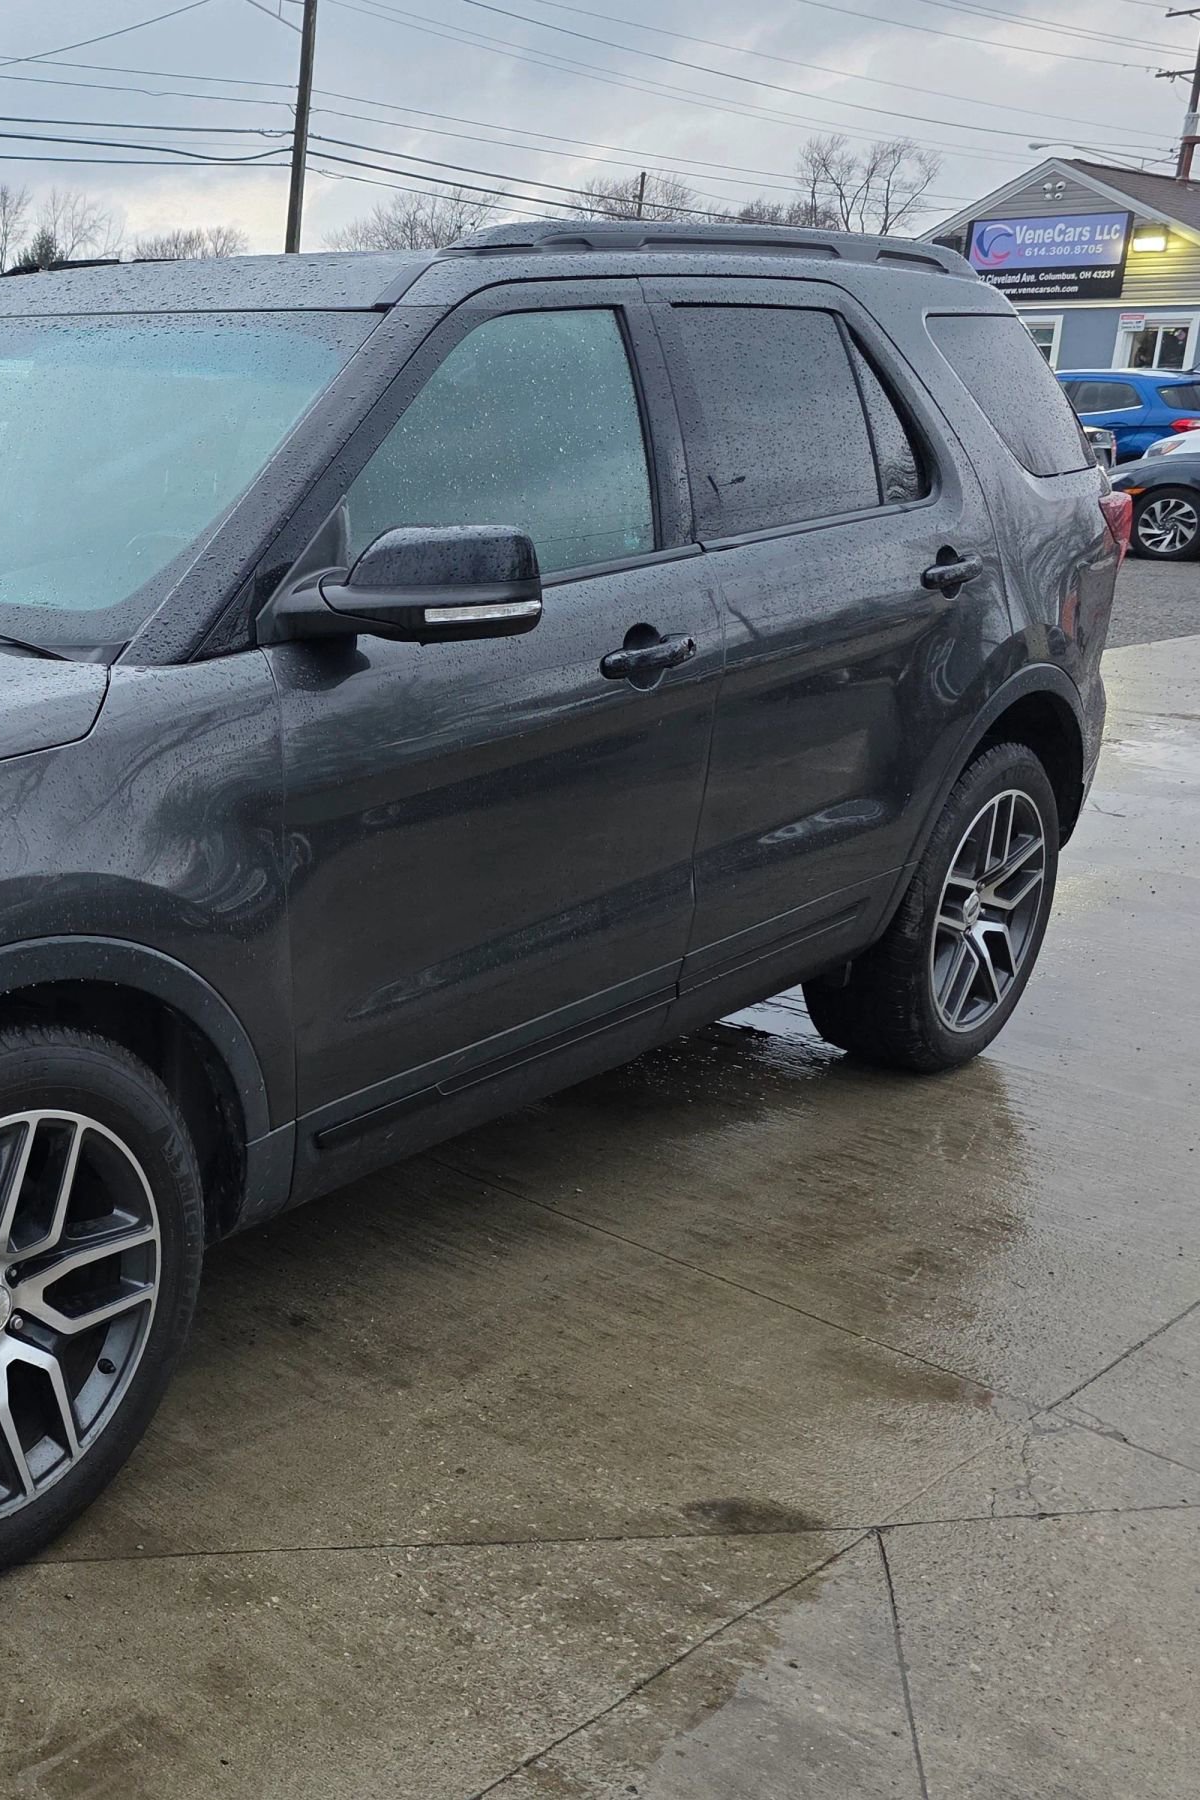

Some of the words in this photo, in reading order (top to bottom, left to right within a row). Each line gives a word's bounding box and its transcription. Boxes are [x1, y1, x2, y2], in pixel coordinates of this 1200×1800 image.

[1015, 223, 1090, 245] VeneCars
[1094, 223, 1121, 241] LLC
[1024, 244, 1104, 257] 614.300.8705
[1038, 271, 1078, 281] Columbus,
[1079, 270, 1092, 280] OH
[1092, 269, 1116, 279] 43231
